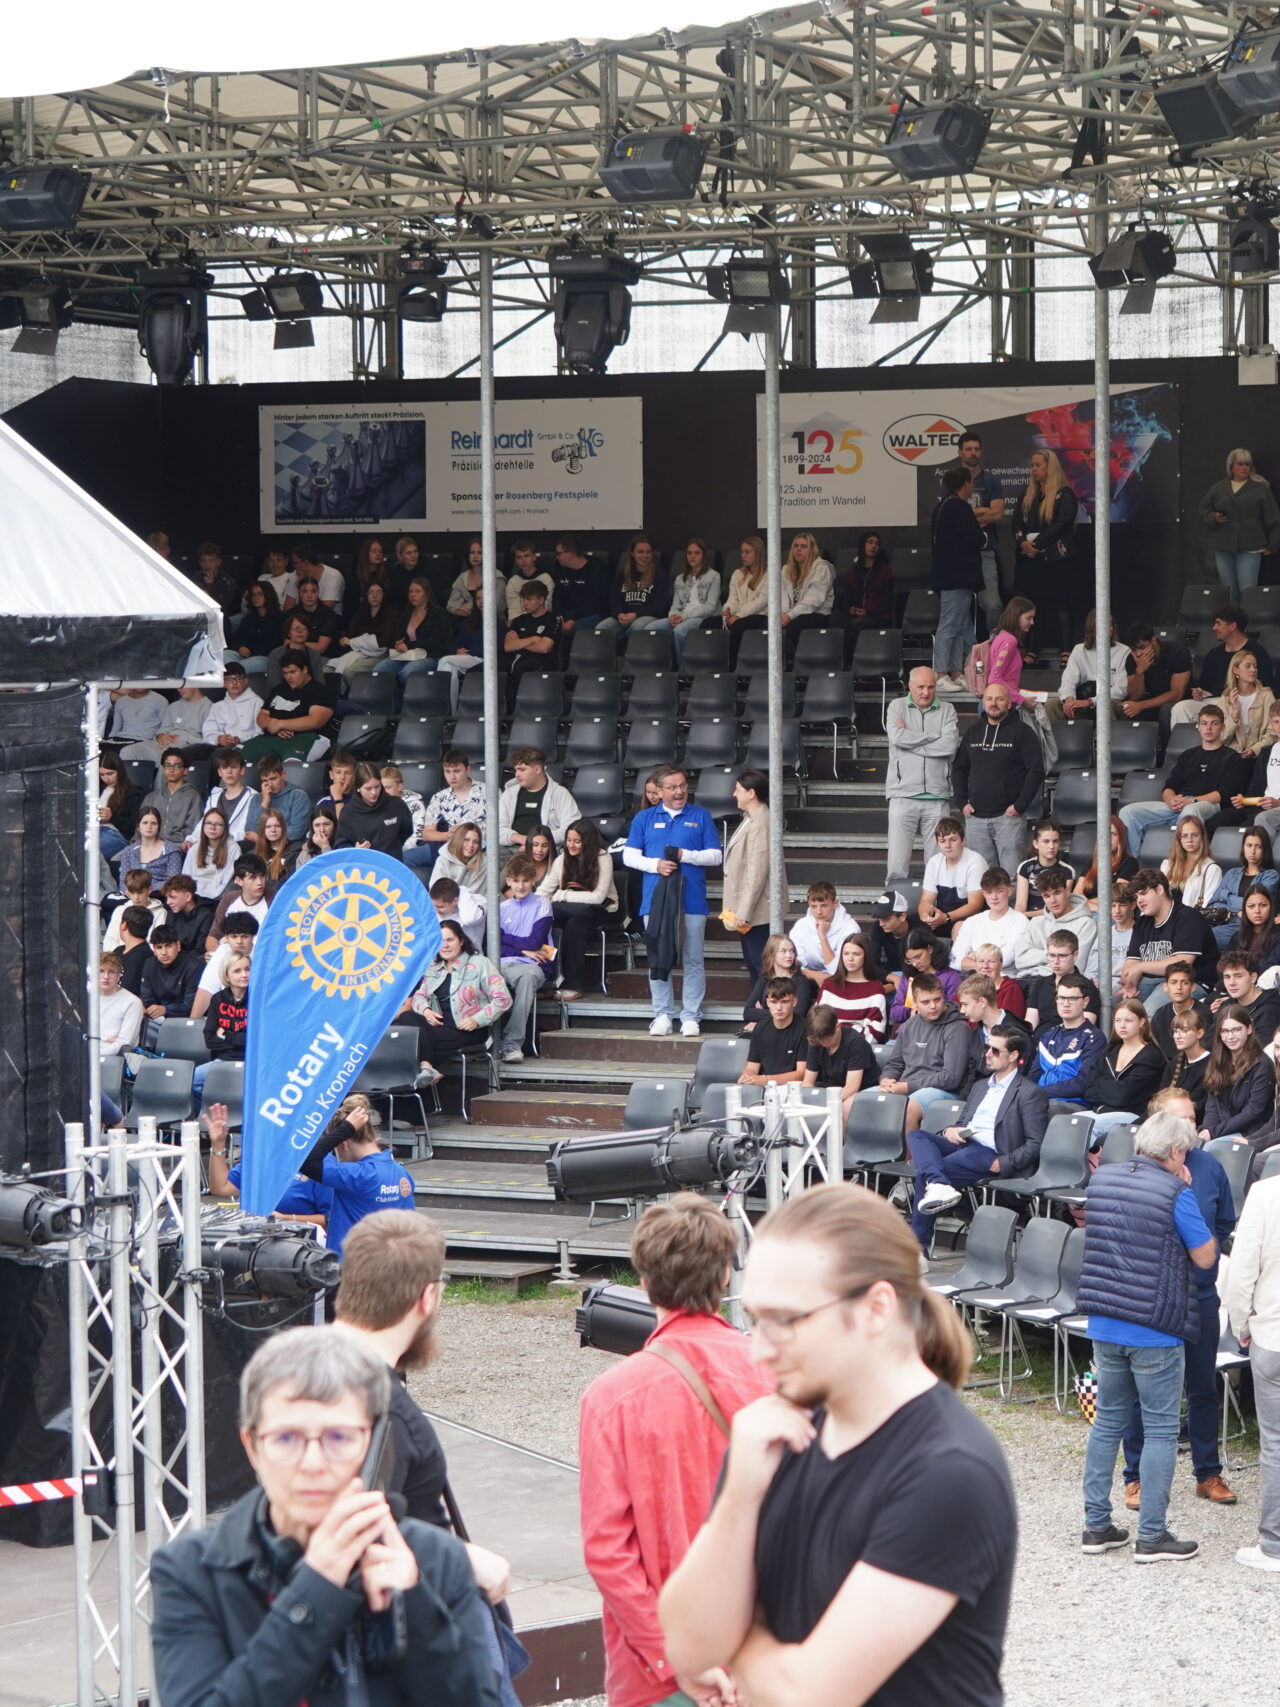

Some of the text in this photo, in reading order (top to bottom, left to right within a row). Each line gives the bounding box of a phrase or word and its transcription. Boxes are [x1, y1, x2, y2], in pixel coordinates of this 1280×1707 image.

[451, 429, 534, 450] Reiardt
[537, 432, 557, 441] GmbH
[783, 454, 831, 464] 1899-2024
[451, 492, 482, 503] Spons
[506, 491, 553, 502] Rosenberg
[554, 490, 599, 501] Festspiele
[797, 485, 822, 494] Jahre
[819, 497, 830, 506] im
[832, 496, 866, 505] Wandel
[301, 888, 334, 935] ROTARY
[345, 906, 402, 986] INTERNATIONAL
[259, 1021, 344, 1128] Rotary
[290, 1042, 368, 1150] Club Kronach
